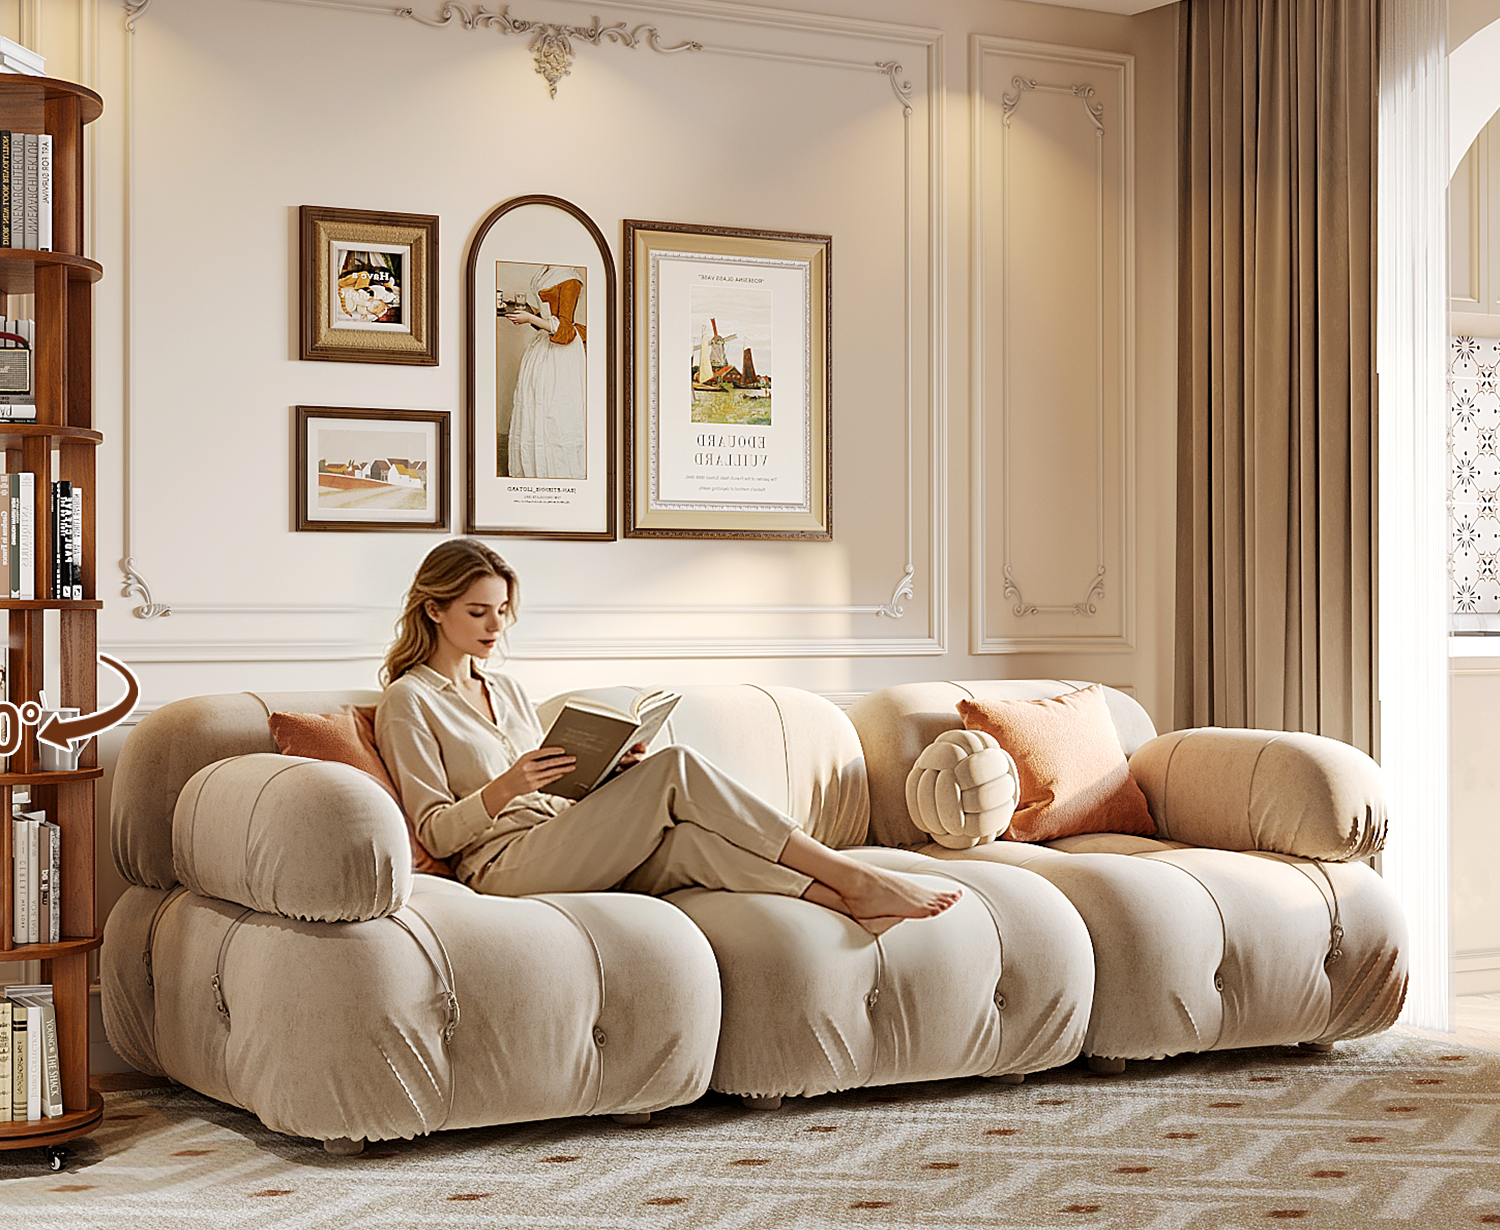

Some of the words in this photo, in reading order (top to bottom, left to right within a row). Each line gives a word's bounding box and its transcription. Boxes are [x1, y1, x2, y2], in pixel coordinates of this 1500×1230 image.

[13, 140, 23, 234] INNENARCHITEKTUR
[46, 1019, 55, 1047] YOUNG
[48, 1054, 57, 1069] THE
[49, 1071, 59, 1096] SHACK
